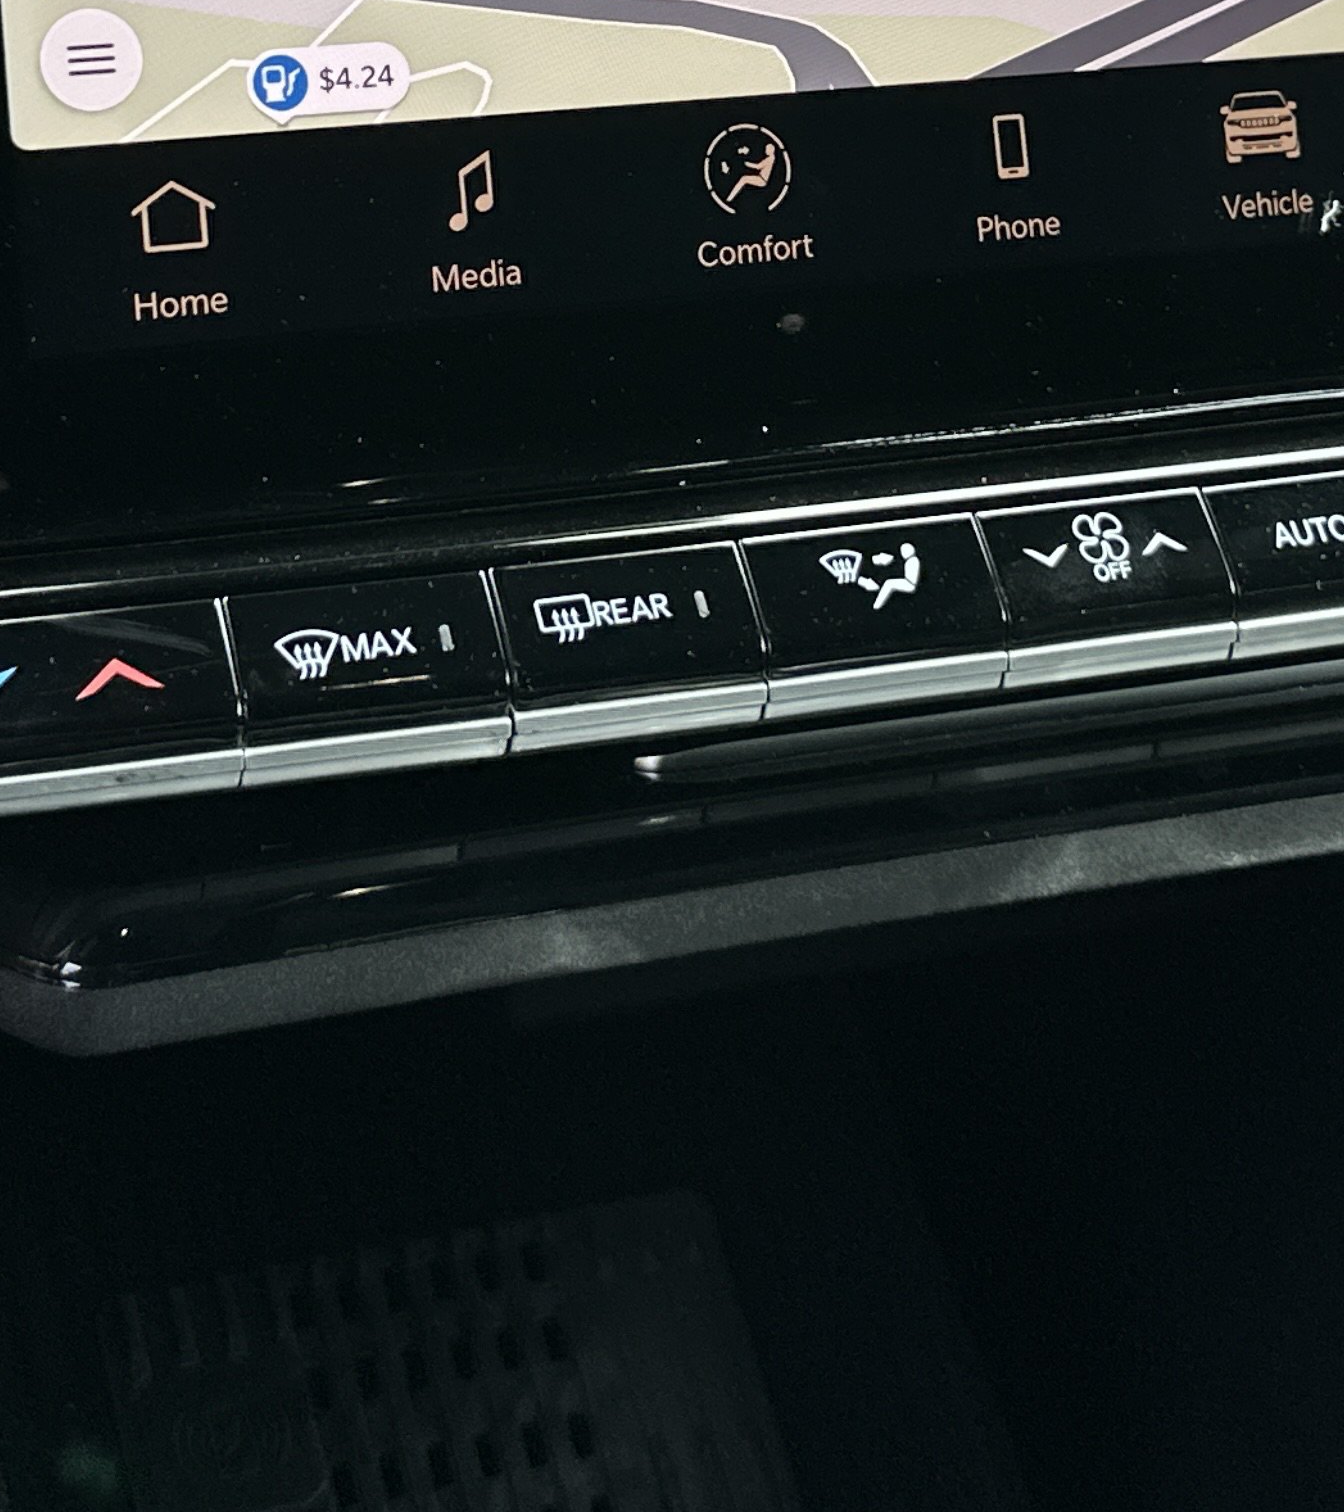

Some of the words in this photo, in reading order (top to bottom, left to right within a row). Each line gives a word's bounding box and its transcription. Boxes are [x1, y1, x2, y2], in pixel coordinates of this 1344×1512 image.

[319, 64, 394, 91] $4.24
[1222, 188, 1314, 221] Vehicle
[977, 212, 1061, 243] Phone
[697, 233, 814, 269] Comfort
[431, 260, 522, 293] Media
[133, 291, 229, 321] Home
[1094, 560, 1132, 583] OFF
[593, 593, 672, 628] REAR
[340, 626, 417, 664] MAX
